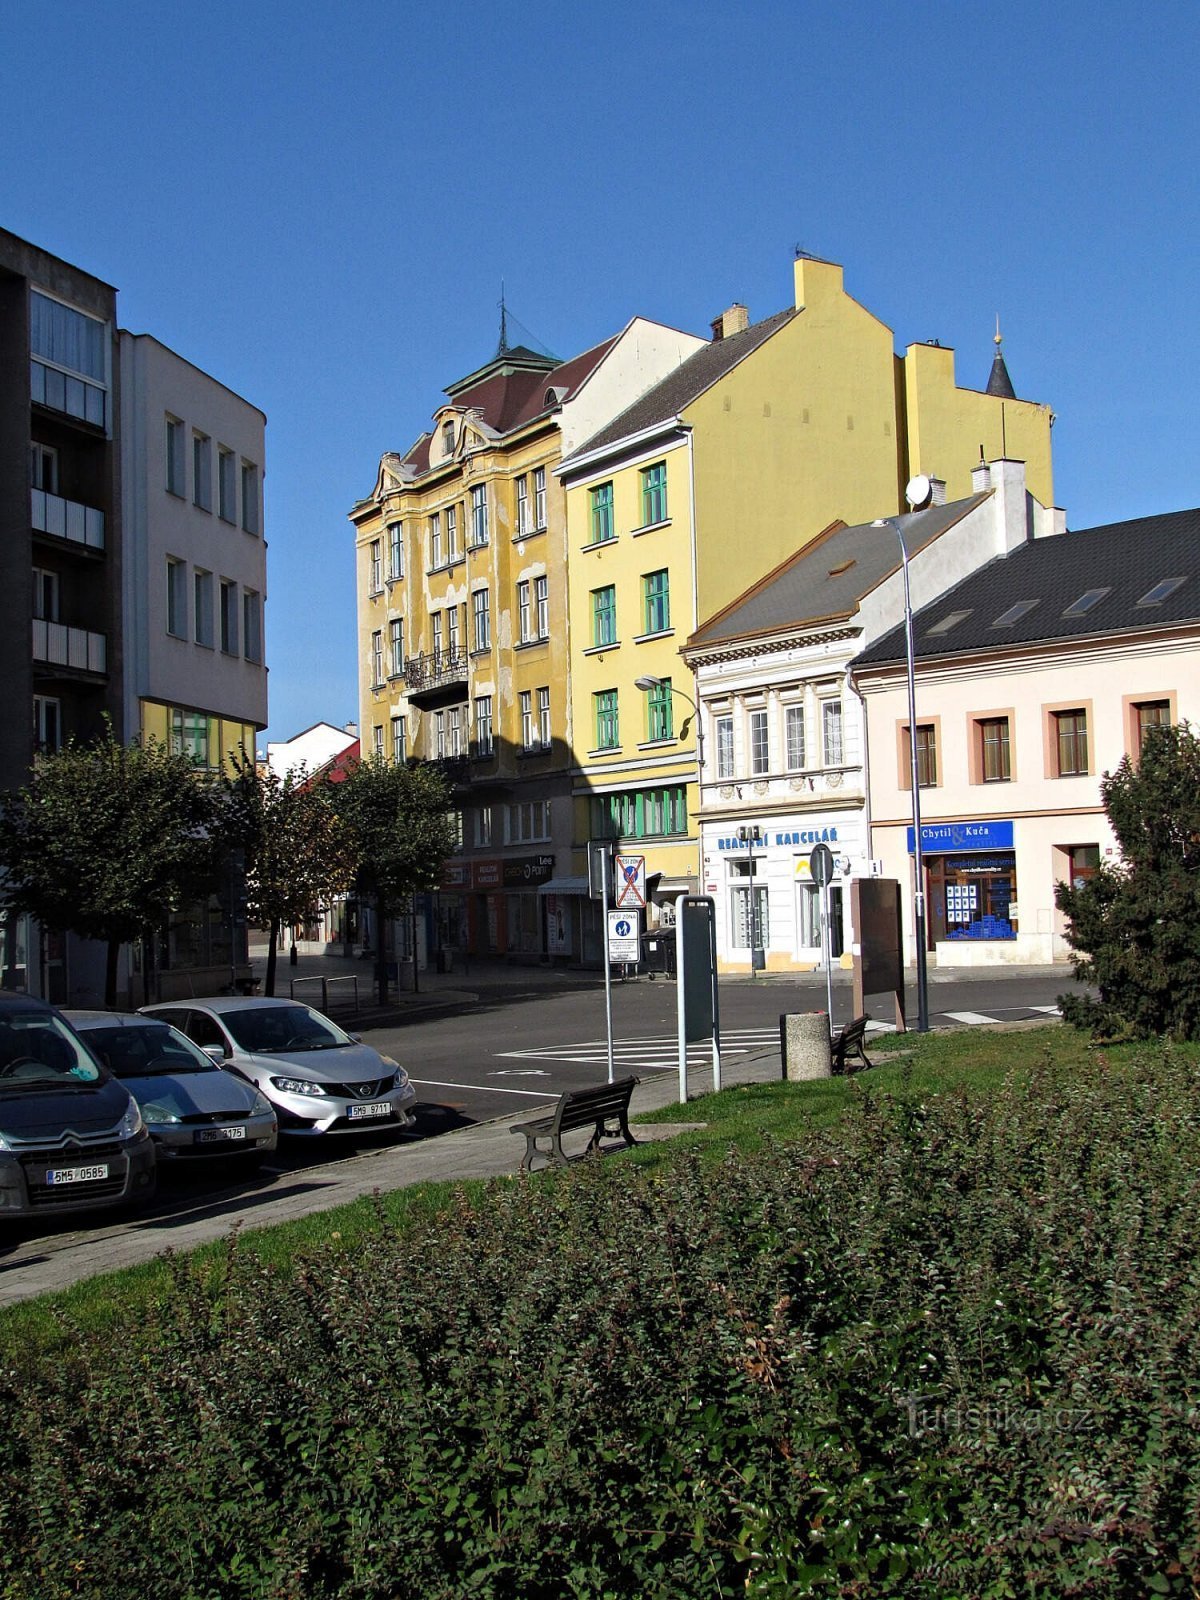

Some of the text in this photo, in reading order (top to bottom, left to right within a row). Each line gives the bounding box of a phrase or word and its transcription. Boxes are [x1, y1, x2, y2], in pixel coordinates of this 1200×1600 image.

[775, 827, 838, 846] KANCELÁŘ
[922, 828, 951, 839] Chytil
[966, 826, 989, 836] Kuča
[539, 856, 553, 865] Lee
[371, 1104, 387, 1114] 9711
[55, 1167, 104, 1182] 5M5 0585
